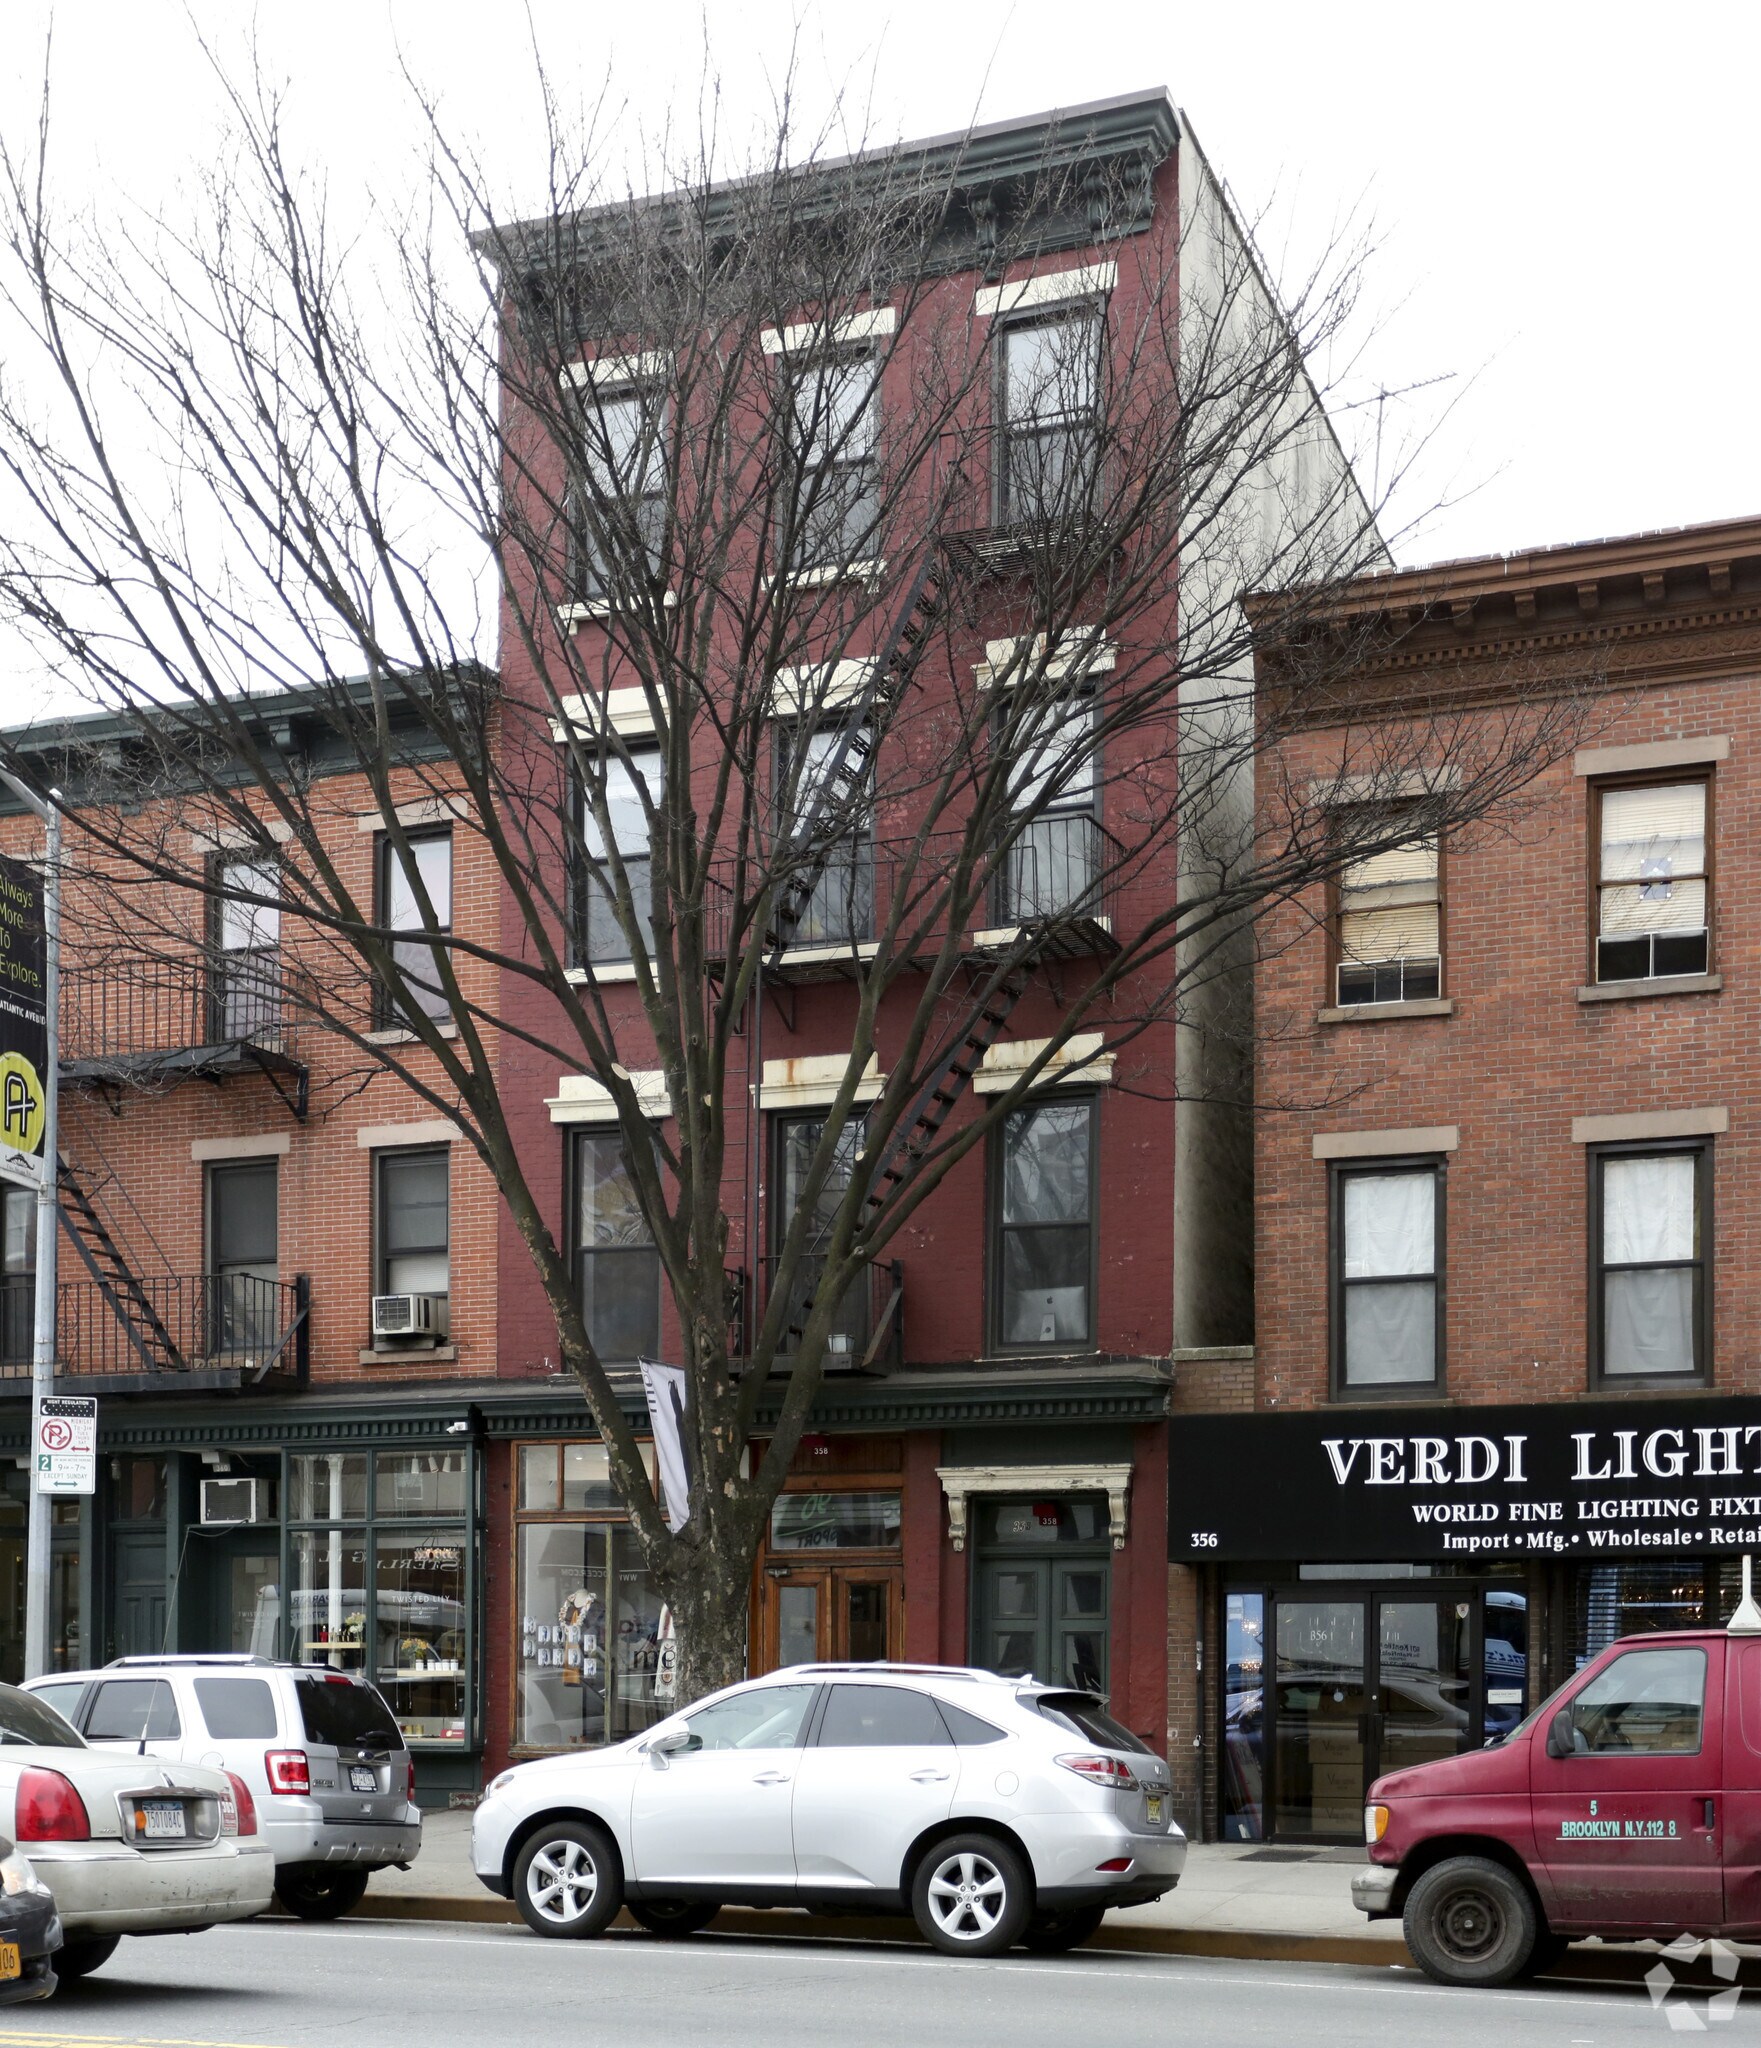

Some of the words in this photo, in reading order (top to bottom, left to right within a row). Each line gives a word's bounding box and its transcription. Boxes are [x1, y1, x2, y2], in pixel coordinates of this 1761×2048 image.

[0, 999, 24, 1018] ATLANTIC
[41, 1456, 49, 1470] 2
[1321, 1436, 1528, 1485] VERDI
[1412, 1504, 1499, 1522] WORLD
[1508, 1502, 1564, 1521] FINE
[1577, 1499, 1700, 1519] LIGHTING
[1042, 1517, 1057, 1525] 358
[1190, 1533, 1218, 1547] 356
[1443, 1532, 1509, 1552] Import
[1526, 1531, 1569, 1551] Mfg.
[1587, 1528, 1692, 1546] Wholesale
[392, 1595, 430, 1603] TWISTED
[432, 1595, 450, 1603] LILY
[1590, 1800, 1598, 1816] 5
[1562, 1821, 1620, 1836] BROOKLYN
